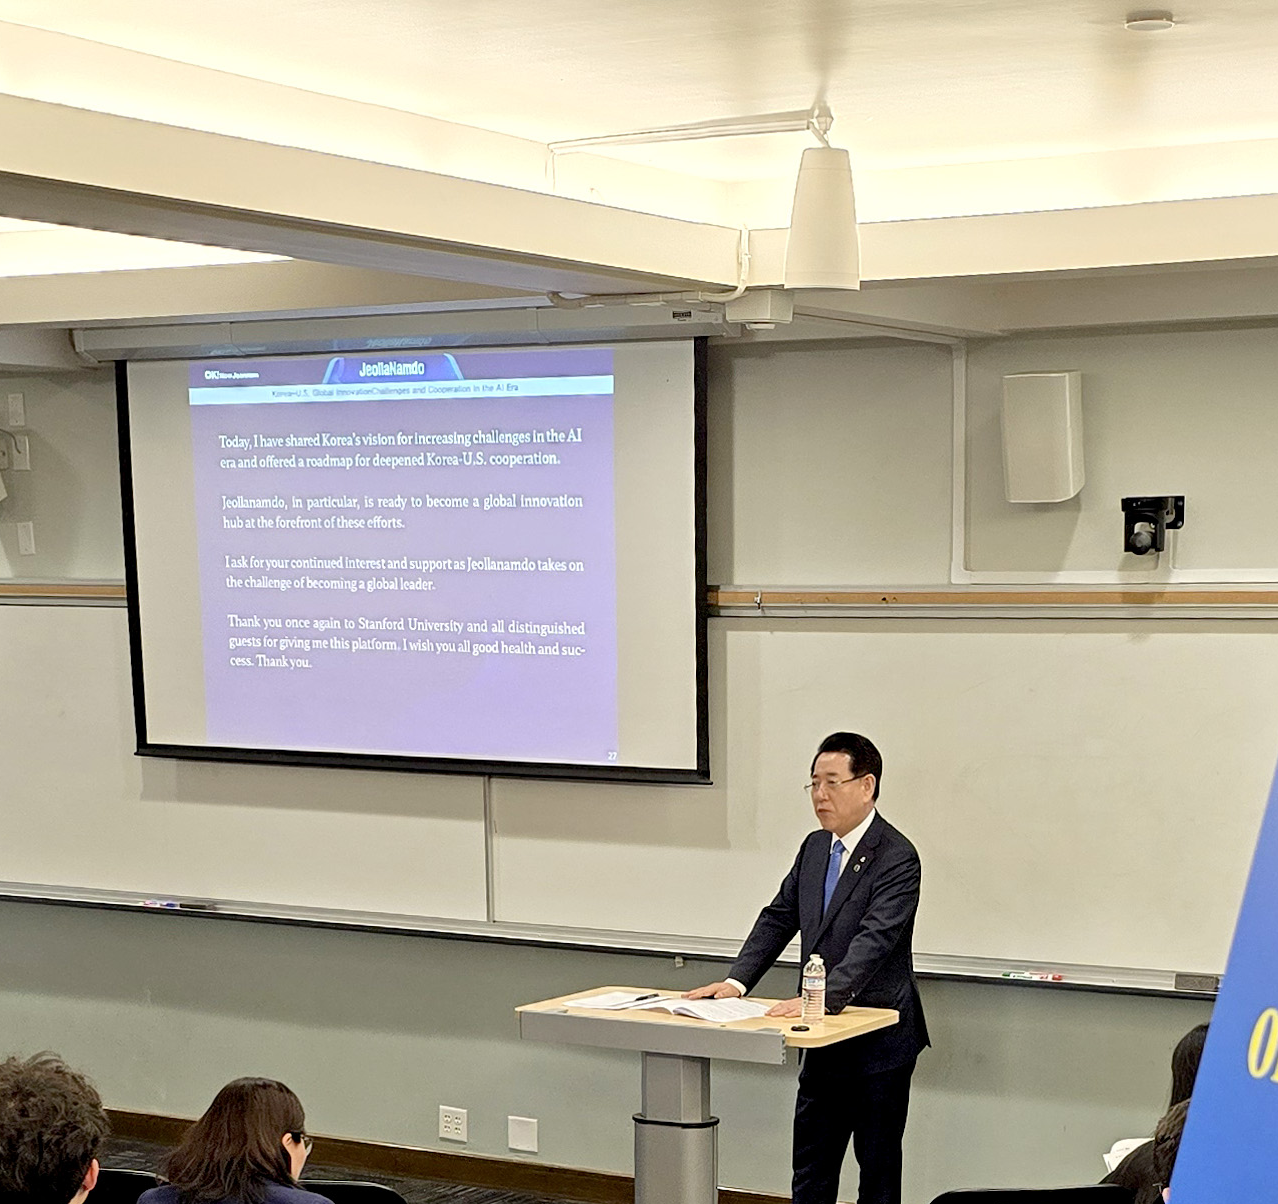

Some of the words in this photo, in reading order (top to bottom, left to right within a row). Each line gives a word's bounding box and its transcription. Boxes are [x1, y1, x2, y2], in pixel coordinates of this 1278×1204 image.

[359, 361, 425, 377] JeollaNamdo
[312, 387, 334, 397] Global
[412, 386, 426, 394] and
[428, 385, 471, 395] Cooperation
[482, 384, 494, 392] the
[506, 383, 519, 391] Era
[219, 435, 252, 450] Today,
[253, 435, 259, 447] I
[259, 435, 284, 447] have
[285, 434, 321, 446] shared
[322, 433, 361, 446] Korea's
[363, 433, 394, 445] vision
[397, 432, 413, 445] for
[414, 431, 471, 446] increasing
[473, 430, 530, 446] challenges
[533, 430, 544, 443] in
[546, 430, 566, 442] the
[567, 428, 582, 442] AI
[221, 459, 237, 469] era
[237, 456, 257, 468] and
[259, 455, 296, 468] offered
[298, 457, 306, 467] a
[307, 454, 353, 469] roadmap
[355, 454, 370, 467] for
[372, 452, 424, 469] deepened
[426, 452, 487, 466] Korea-U.S.
[489, 452, 560, 469] cooperation.
[221, 496, 288, 510] Jeollanamdo,
[292, 496, 303, 508] in
[306, 496, 360, 511] particular,
[364, 495, 374, 508] is
[377, 494, 407, 510] ready
[411, 497, 422, 508] to
[426, 494, 469, 508] become
[472, 497, 480, 508] a
[483, 493, 516, 511] global
[521, 494, 583, 508] innovation
[223, 515, 243, 528] hub
[245, 517, 256, 528] at
[257, 515, 273, 528] the
[275, 515, 321, 528] forefront
[323, 515, 335, 528] of
[337, 515, 365, 528] these
[366, 516, 405, 528] efforts.
[225, 555, 230, 568] I
[231, 555, 248, 568] ask
[249, 556, 264, 568] for
[265, 559, 290, 571] your
[290, 556, 343, 569] continued
[345, 557, 386, 569] interest
[387, 556, 407, 569] and
[409, 559, 452, 572] support
[453, 560, 465, 570] as
[467, 557, 535, 572] Jeollanamdo
[537, 558, 567, 571] takes
[568, 561, 584, 571] on
[226, 575, 243, 588] the
[244, 576, 292, 591] challenge
[293, 576, 306, 589] of
[306, 576, 358, 592] becoming
[358, 580, 365, 590] a
[366, 577, 398, 592] global
[400, 577, 436, 591] leader.
[227, 614, 261, 628] Thank
[263, 617, 282, 630] you
[285, 618, 310, 628] once
[313, 617, 341, 631] again
[344, 618, 355, 629] to
[358, 617, 404, 630] Stanford
[407, 618, 463, 634] University
[467, 619, 487, 633] and
[491, 620, 504, 633] all
[508, 620, 585, 637] distinguished
[229, 636, 262, 649] guests
[263, 635, 278, 648] for
[279, 636, 311, 651] giving
[312, 639, 328, 649] me
[330, 637, 350, 649] this
[351, 637, 401, 652] platform.
[402, 638, 407, 650] I
[409, 638, 436, 651] wish
[436, 642, 456, 654] you
[458, 640, 470, 653] all
[472, 641, 499, 656] good
[501, 641, 536, 655] health
[538, 642, 559, 655] and
[561, 645, 586, 655] suc-
[230, 655, 254, 666] cess.
[255, 654, 289, 668] Thank
[289, 657, 313, 670] you.
[607, 752, 618, 761] 27
